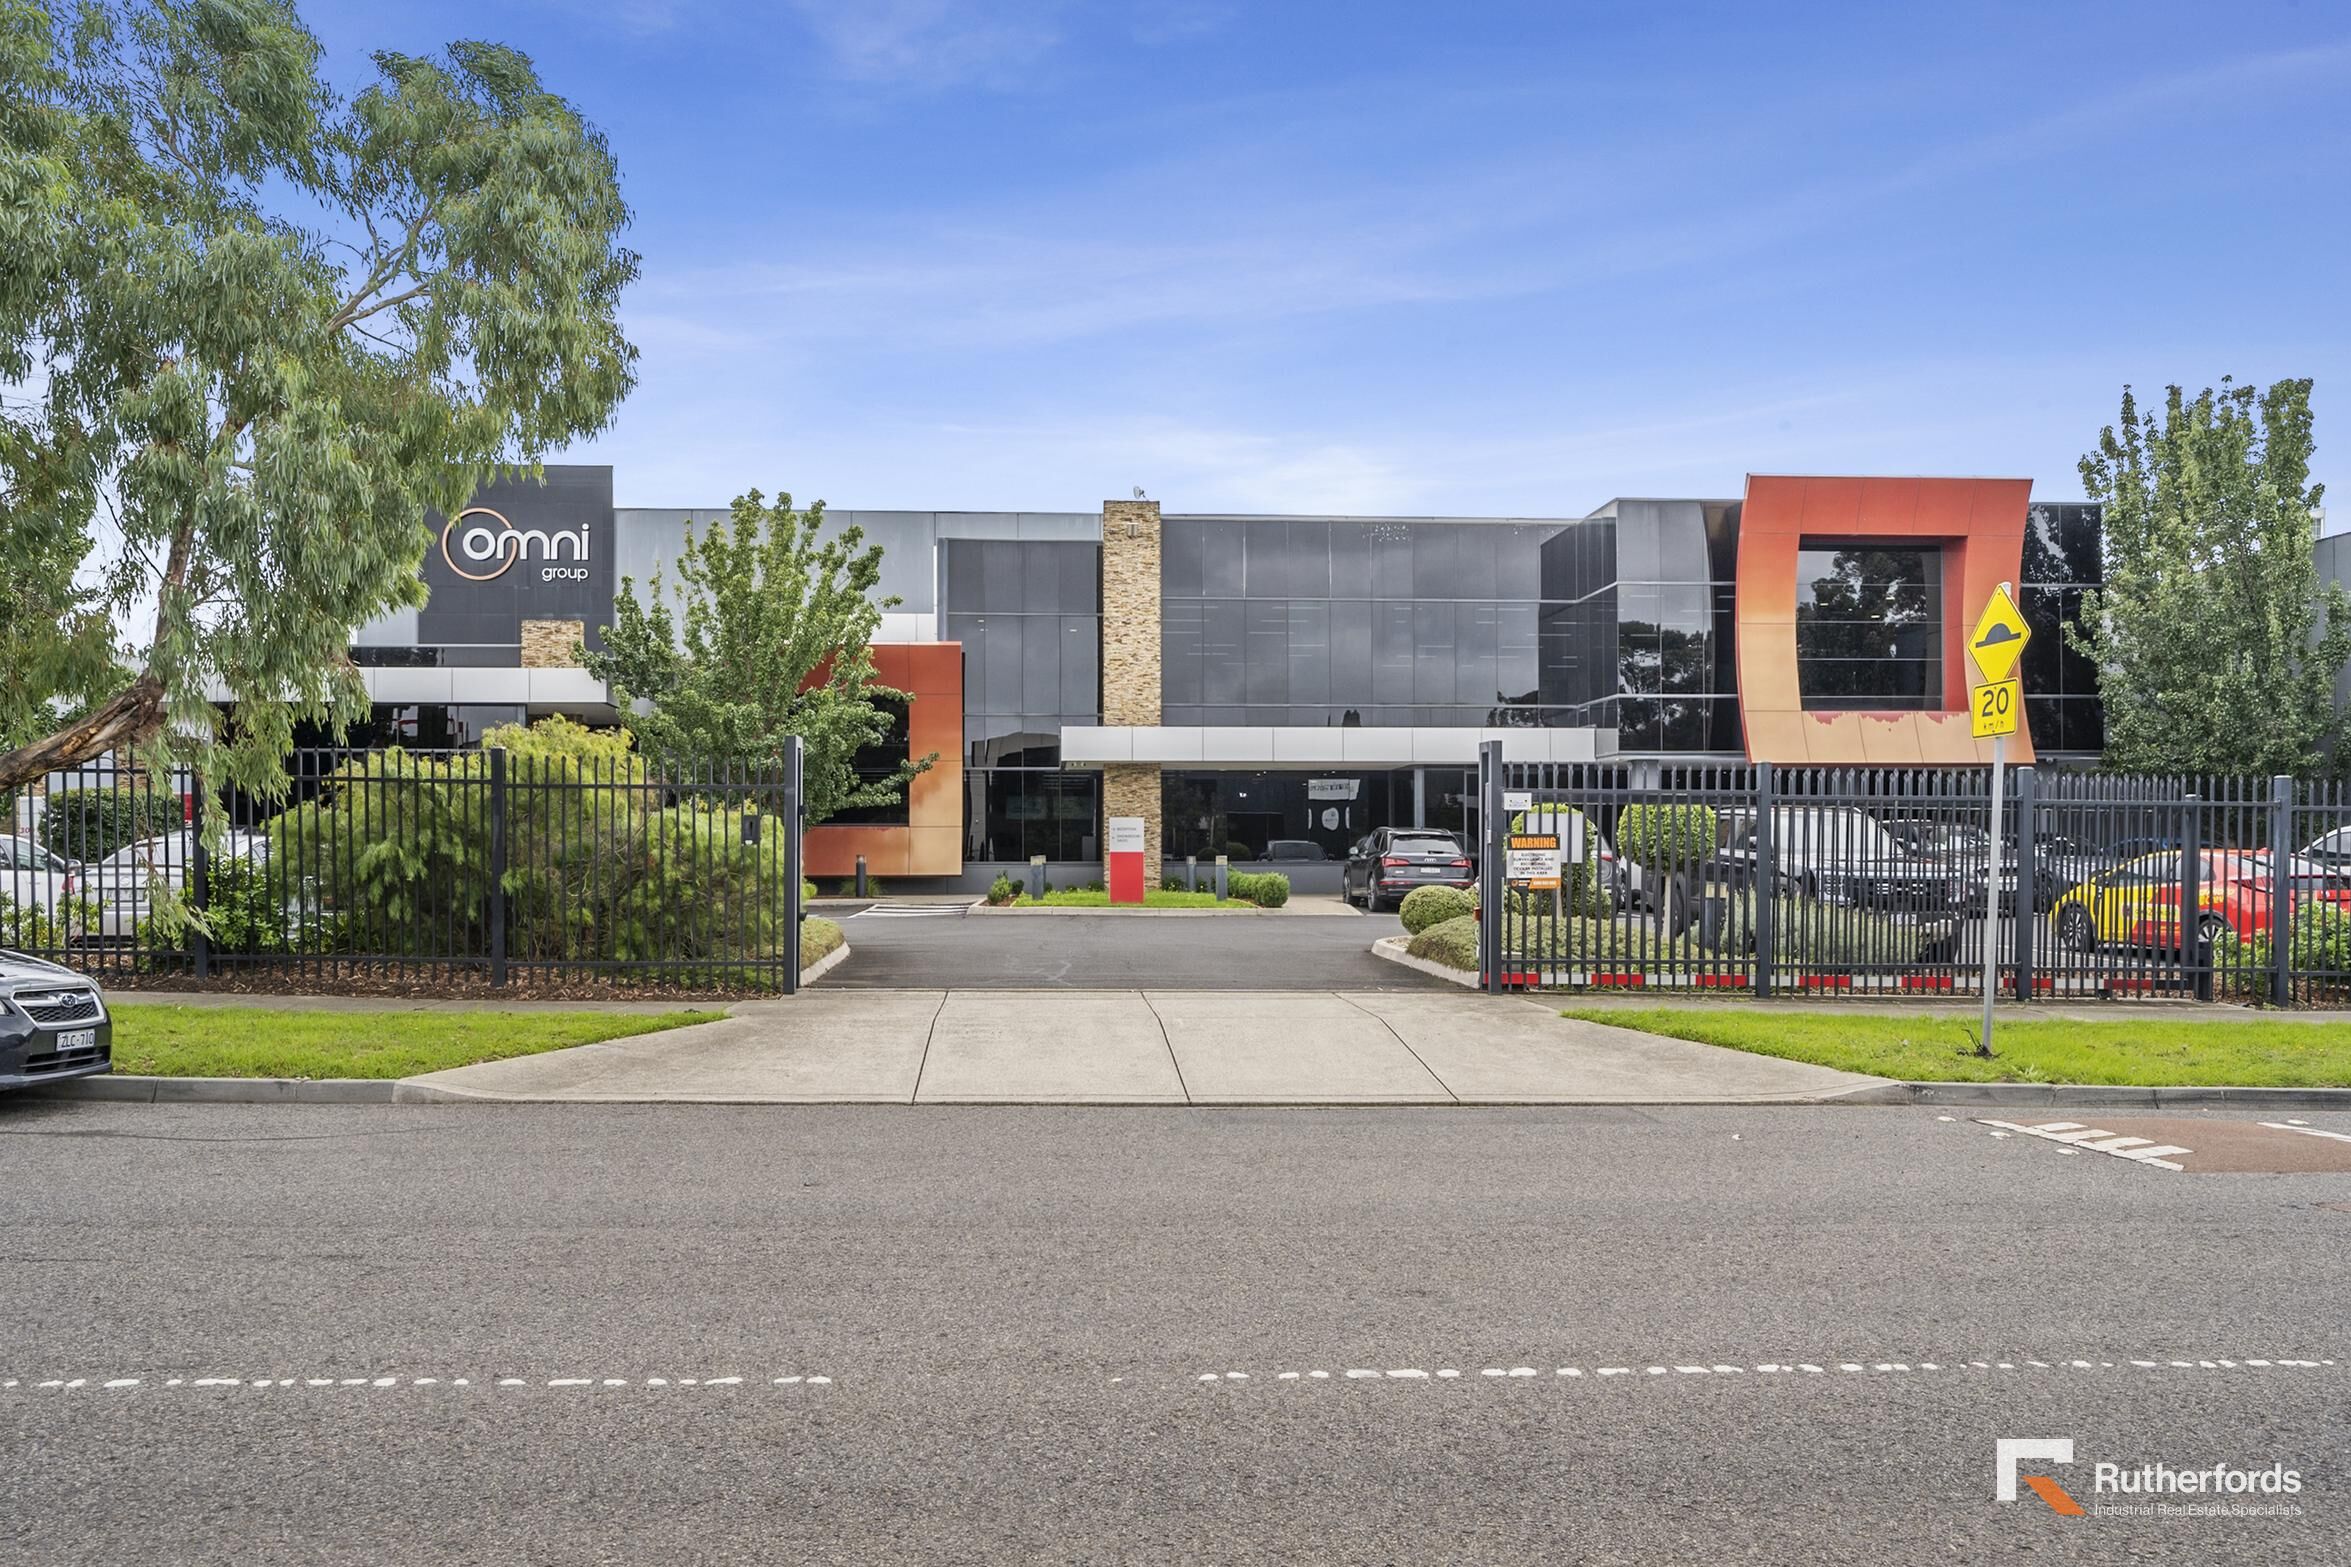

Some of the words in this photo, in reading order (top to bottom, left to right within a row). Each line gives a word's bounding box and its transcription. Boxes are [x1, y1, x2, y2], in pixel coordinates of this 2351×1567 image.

[462, 523, 590, 561] omni
[541, 567, 588, 582] group
[1982, 687, 2009, 717] 20
[1511, 837, 1557, 848] WARNING
